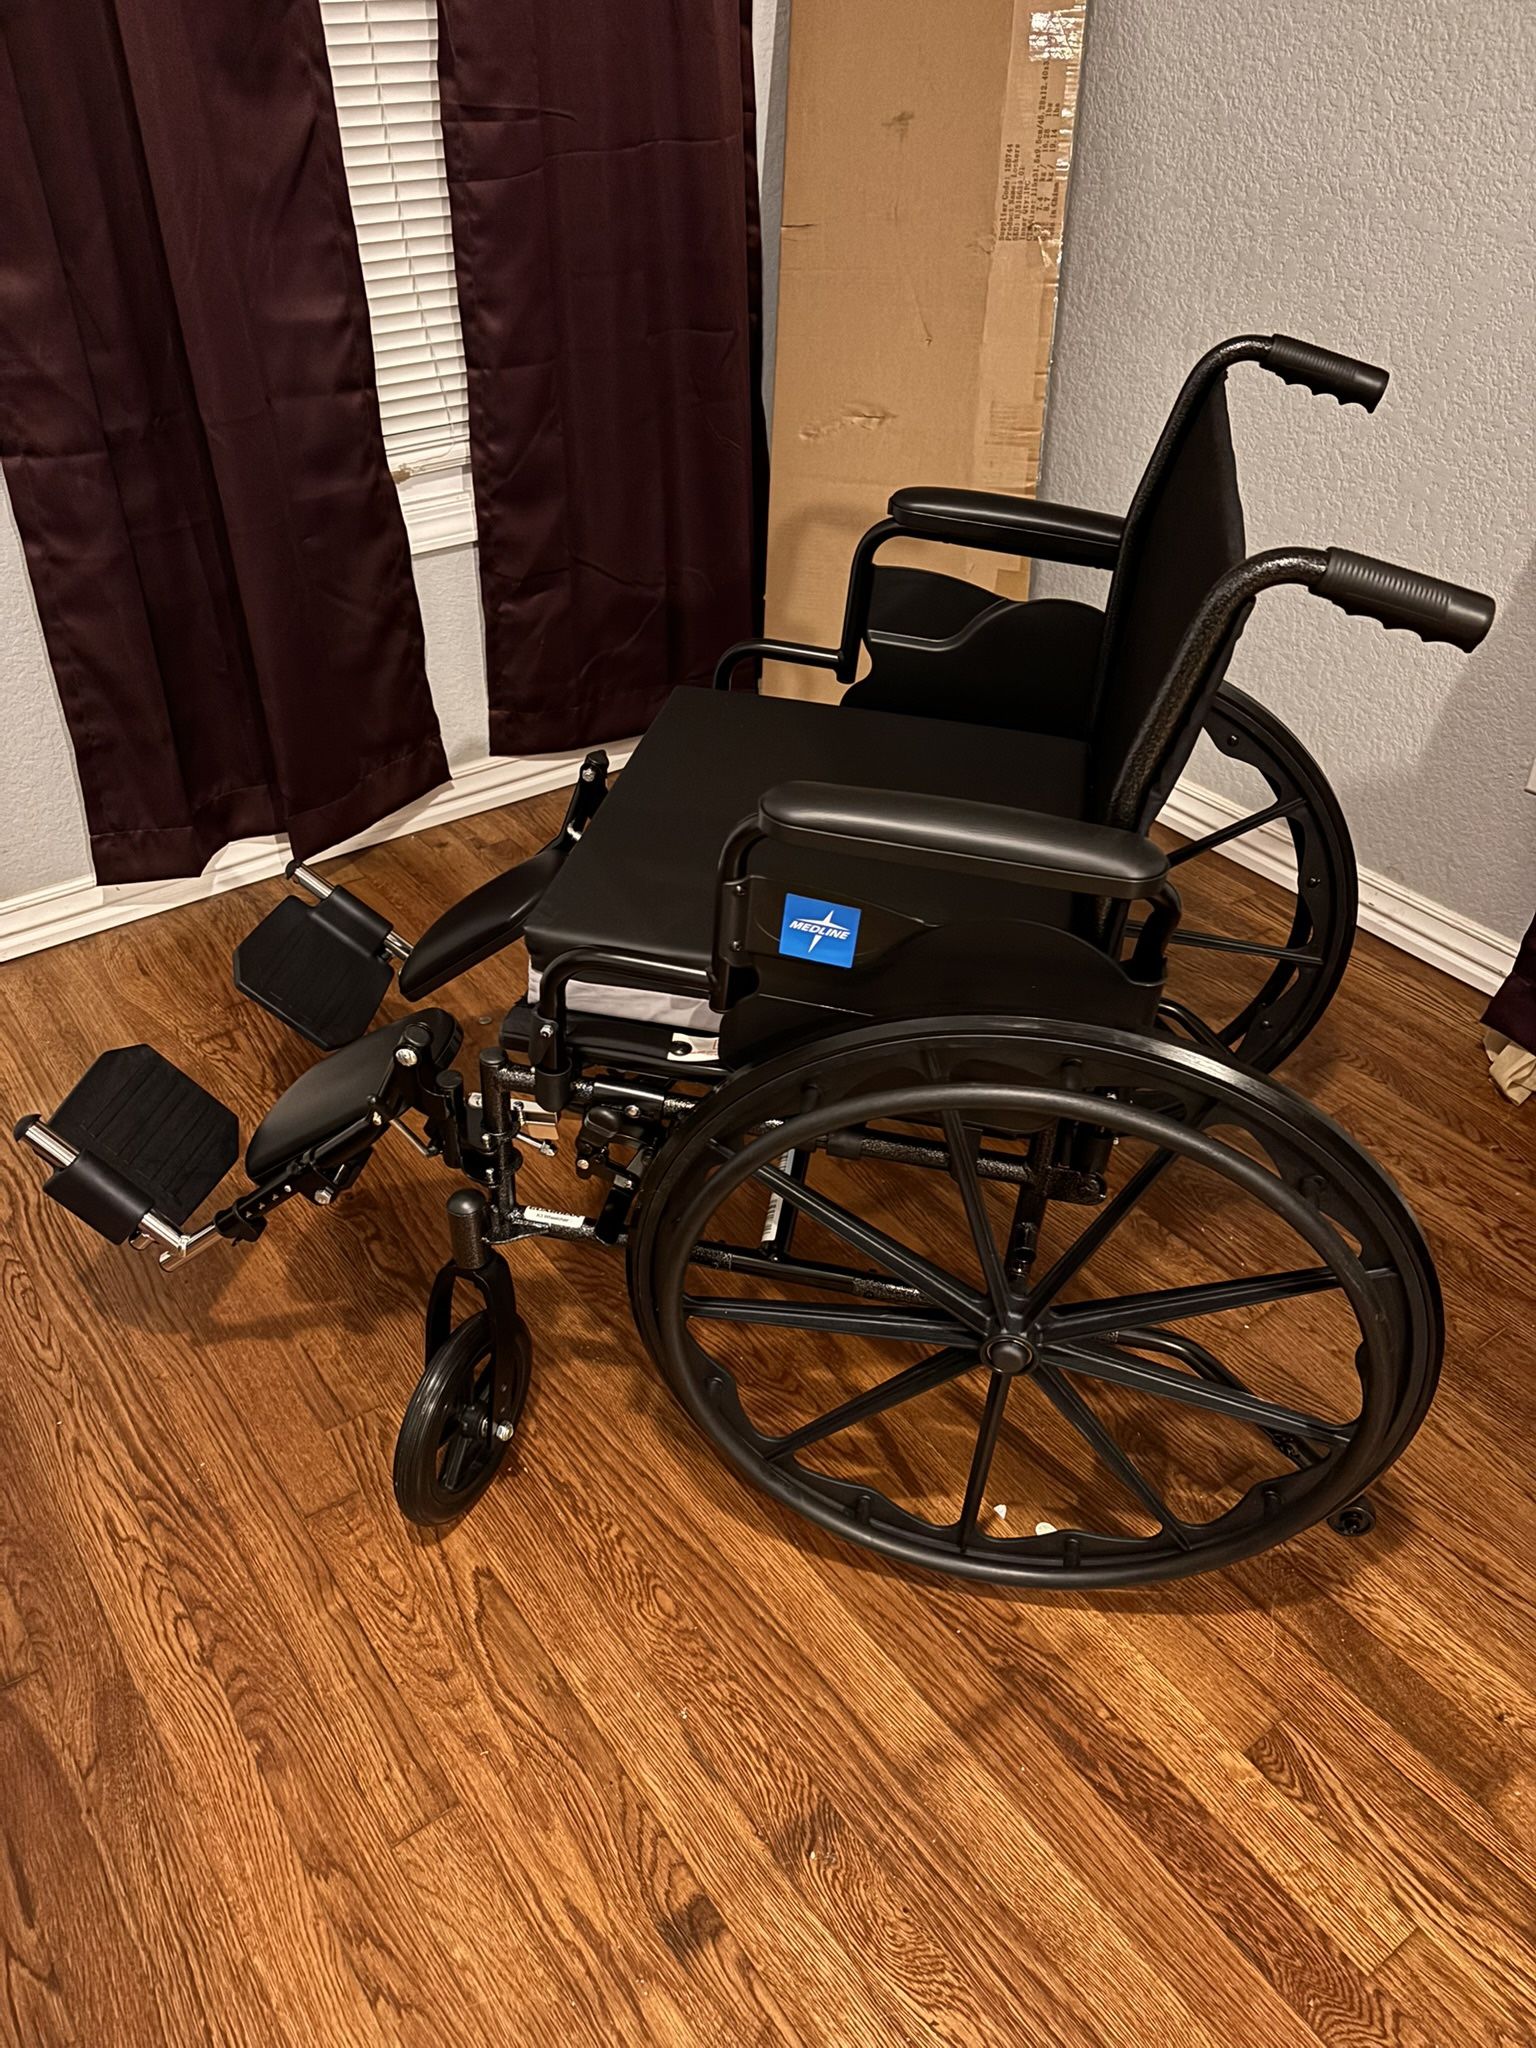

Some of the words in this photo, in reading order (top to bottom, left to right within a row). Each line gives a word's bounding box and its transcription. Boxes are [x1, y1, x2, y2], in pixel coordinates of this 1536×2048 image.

[1011, 143, 1020, 177] Lockers
[1002, 176, 1010, 200] Code:
[1008, 181, 1017, 204] Name:
[999, 203, 1008, 241] Supplier
[1006, 207, 1014, 241] Product
[1019, 217, 1027, 240] Inner
[789, 920, 851, 940] MEDLINE
